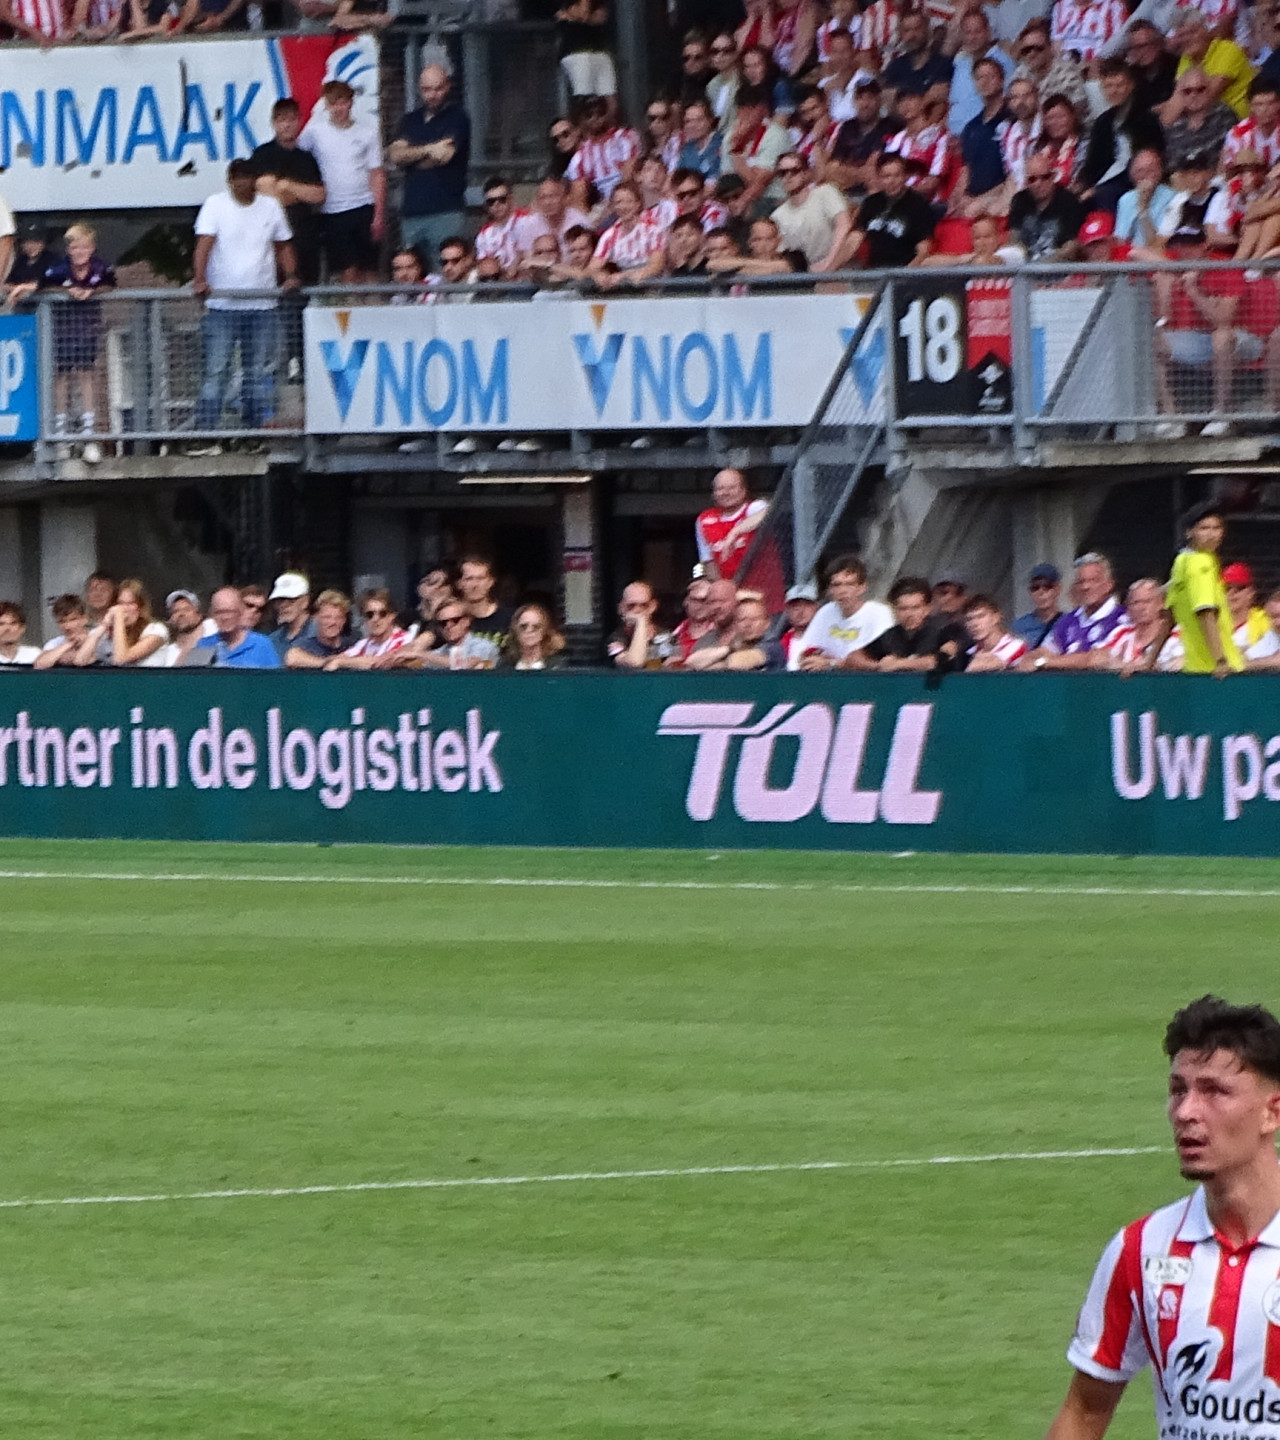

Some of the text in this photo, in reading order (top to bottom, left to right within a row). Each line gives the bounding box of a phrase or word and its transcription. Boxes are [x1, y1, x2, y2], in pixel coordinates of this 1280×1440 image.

[899, 298, 961, 383] 18
[130, 707, 177, 789] in
[189, 707, 256, 790] de
[268, 706, 504, 809] logistiek
[656, 702, 942, 824] TOLL
[1110, 710, 1209, 800] Uw
